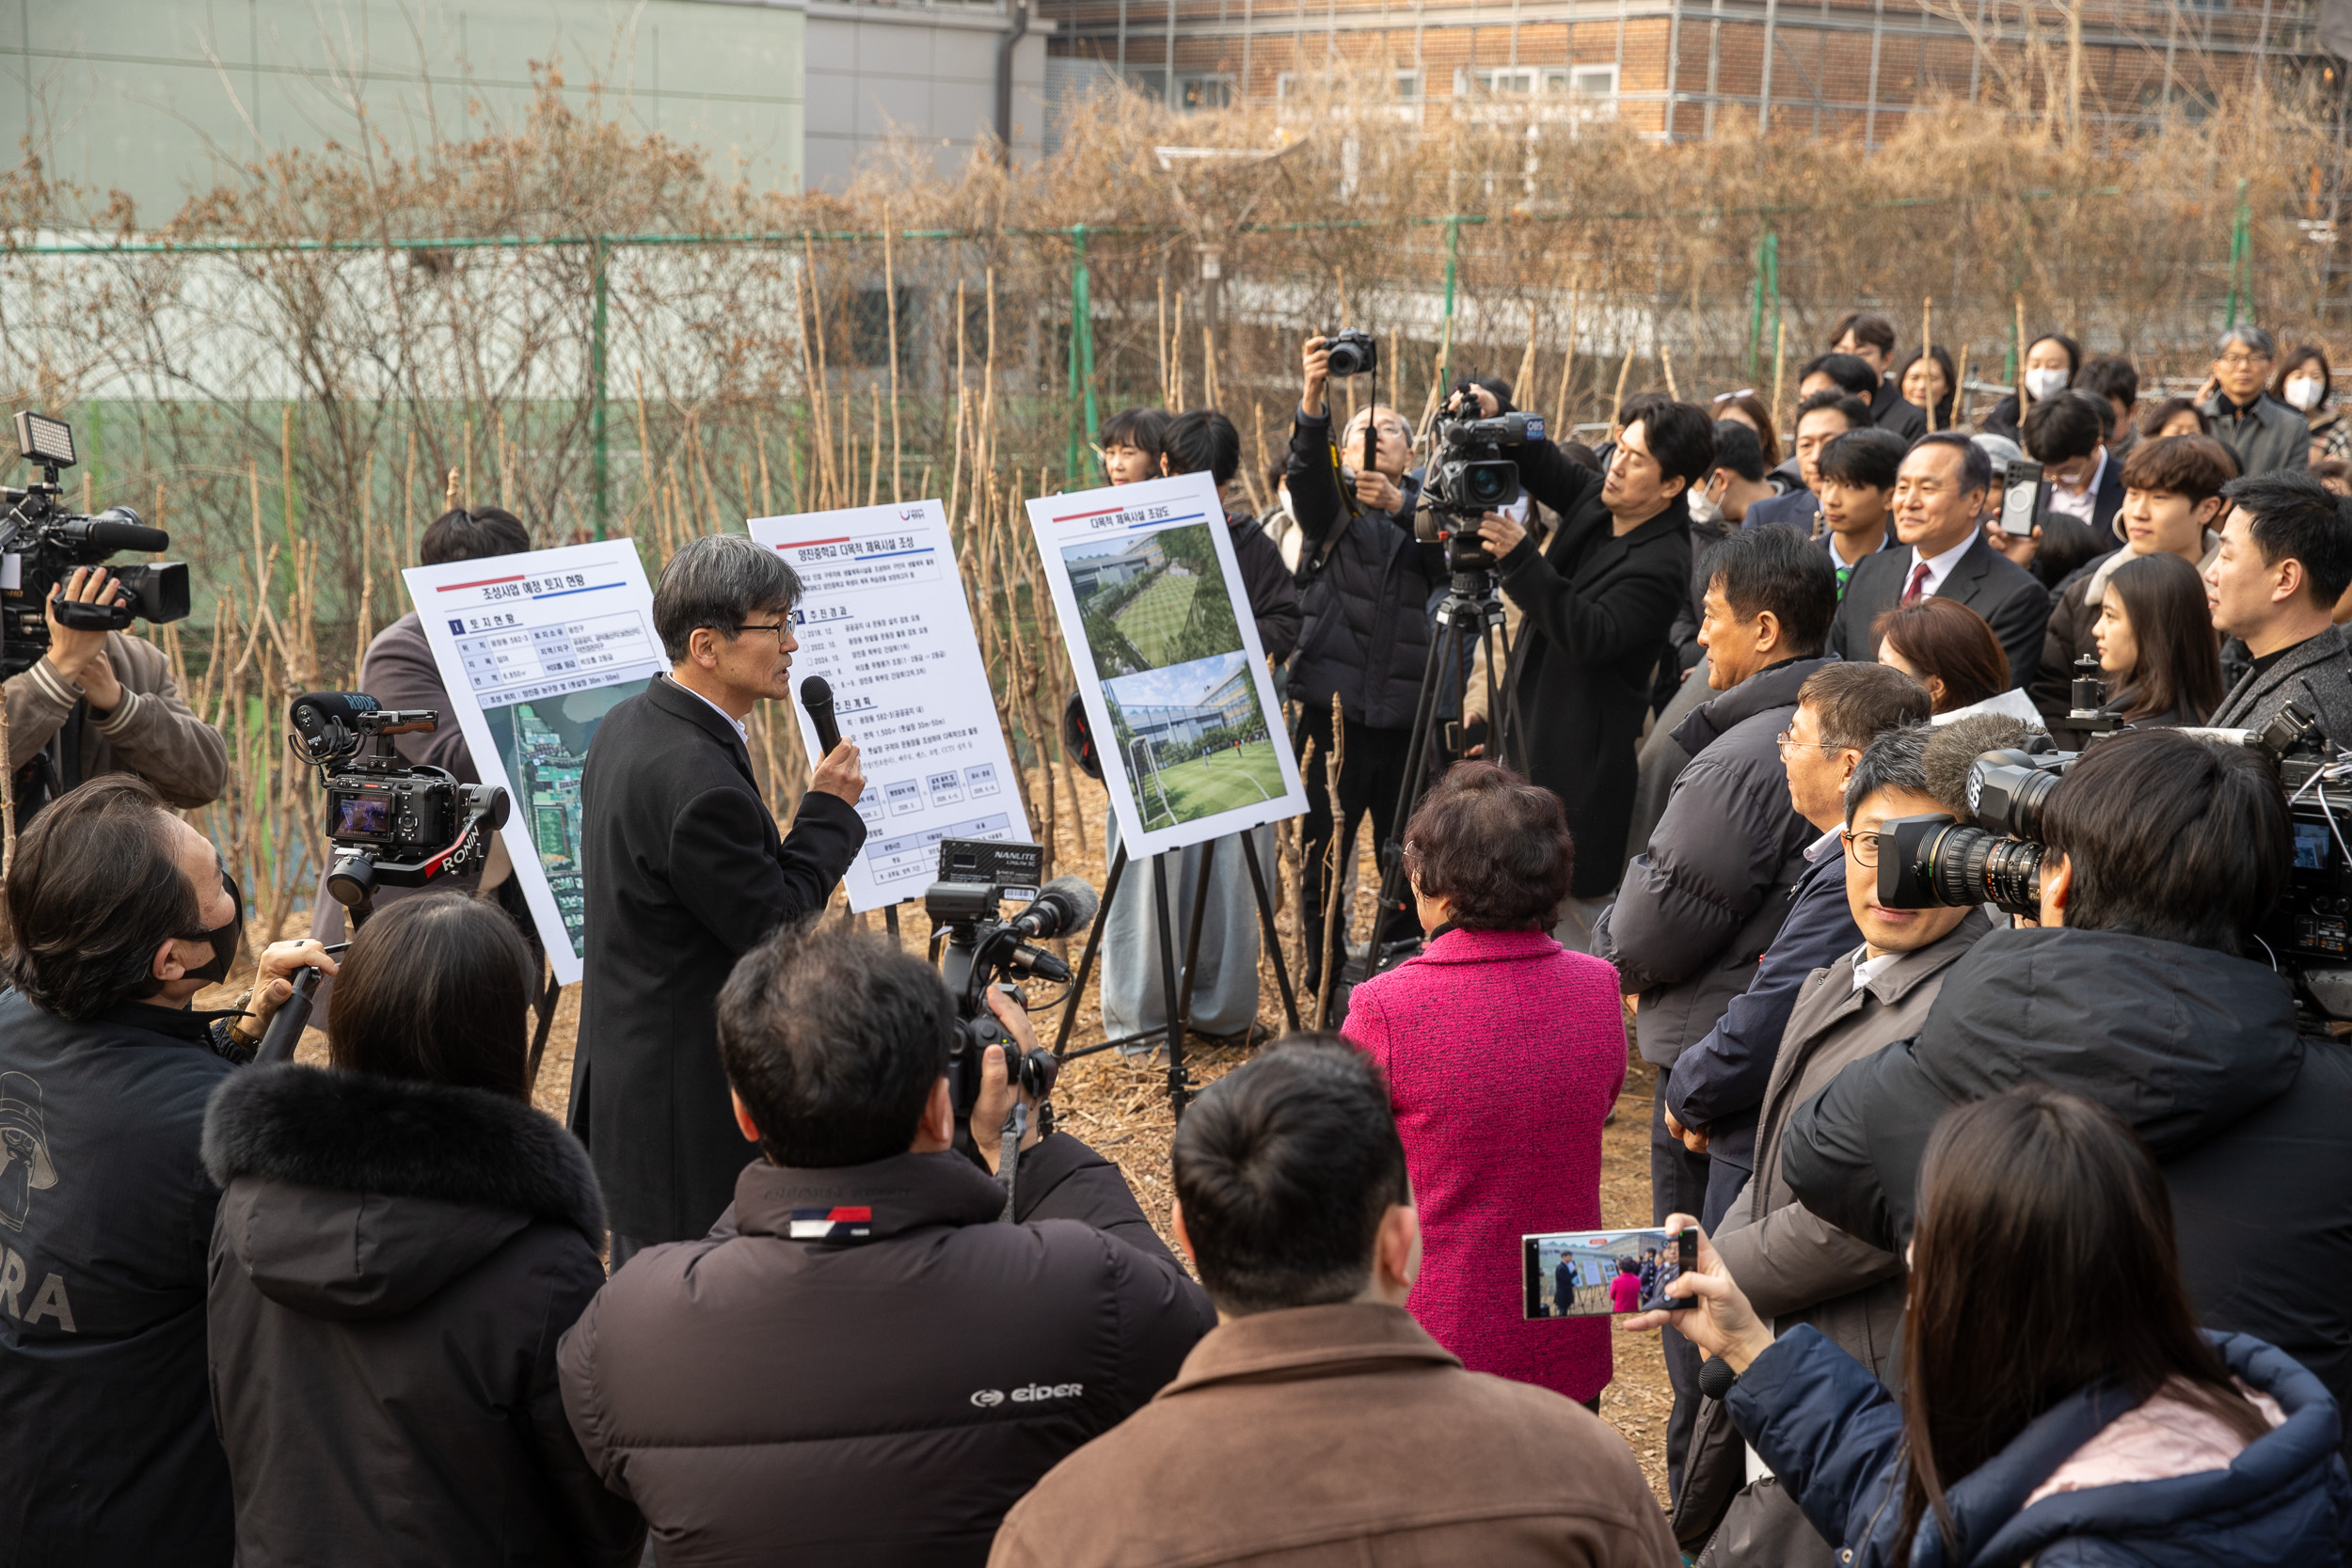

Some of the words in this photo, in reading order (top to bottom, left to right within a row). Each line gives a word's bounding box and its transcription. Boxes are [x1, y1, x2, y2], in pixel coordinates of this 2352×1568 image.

[1090, 516, 1114, 529] 다목적
[1116, 510, 1145, 524] 체육시설
[1148, 506, 1170, 520] 조감도
[798, 546, 837, 562] 양진중학교
[839, 542, 864, 556] 다목적
[865, 538, 896, 553] 체육시설
[898, 536, 914, 549] 조성
[482, 584, 520, 600] 조성사업
[521, 580, 542, 594] 예정
[544, 578, 564, 590] 토지
[565, 574, 585, 587] 현황
[441, 825, 480, 871] RONIN
[994, 850, 1037, 861] NANLITE
[0, 1242, 77, 1333] RA
